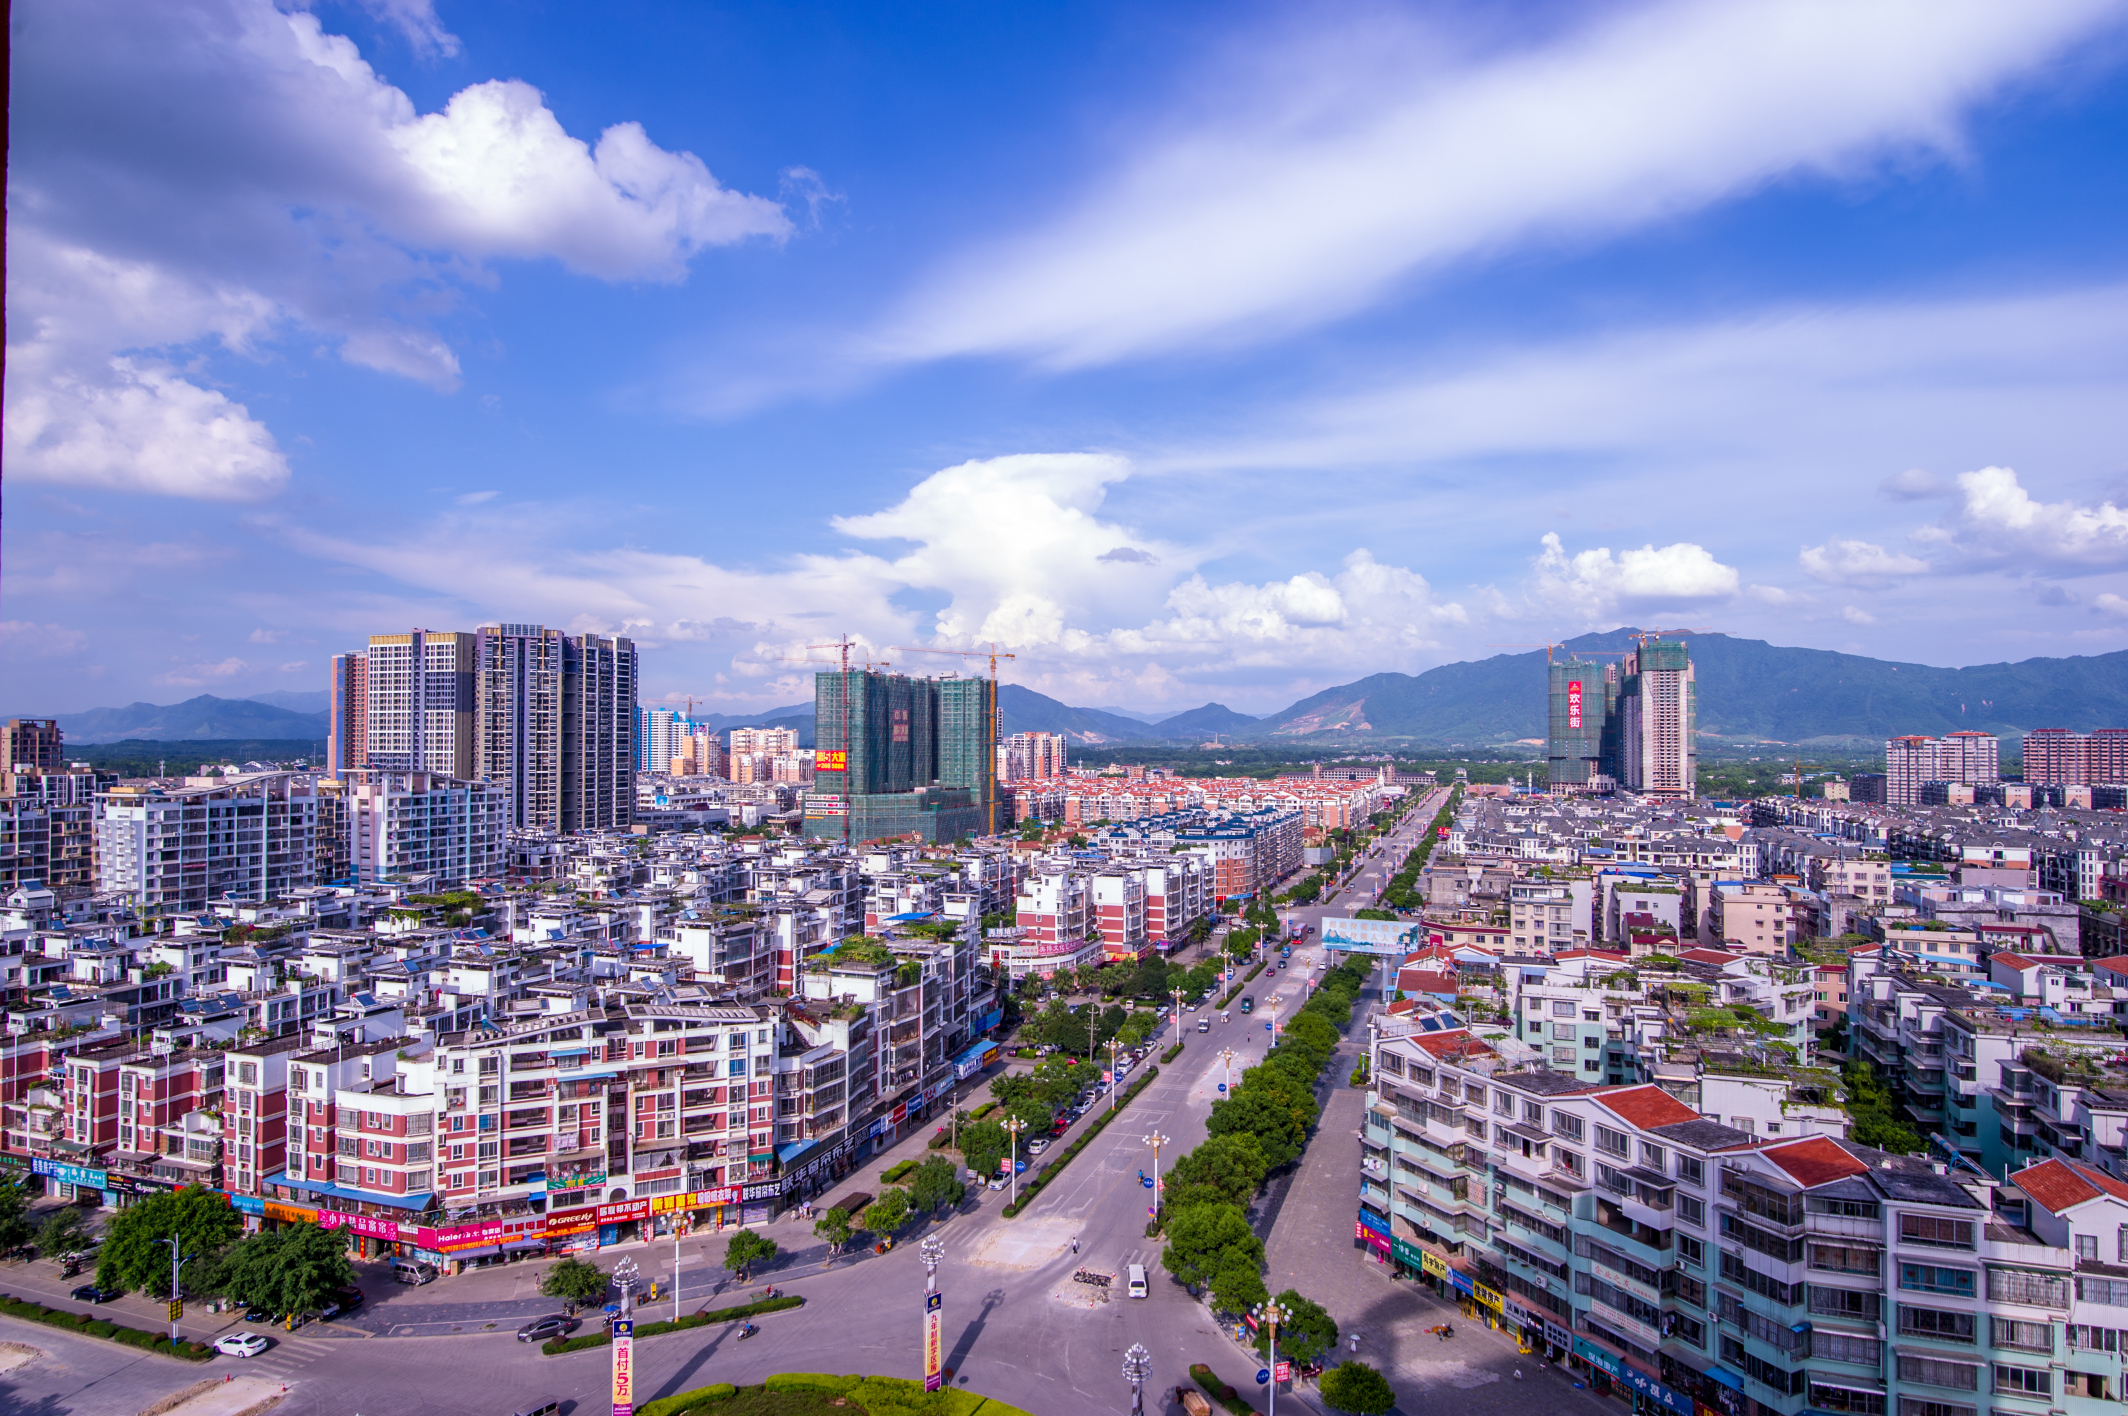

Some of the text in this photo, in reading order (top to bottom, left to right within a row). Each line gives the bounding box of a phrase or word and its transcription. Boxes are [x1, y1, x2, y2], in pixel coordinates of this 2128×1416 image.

[1569, 693, 1581, 728] 欢乐街
[742, 1182, 781, 1201] 联华窗帘布艺
[557, 1214, 582, 1225] GREE
[438, 1233, 462, 1243] Haier
[1594, 1264, 1632, 1291] 企业之友
[616, 1347, 630, 1397] 首付5万
